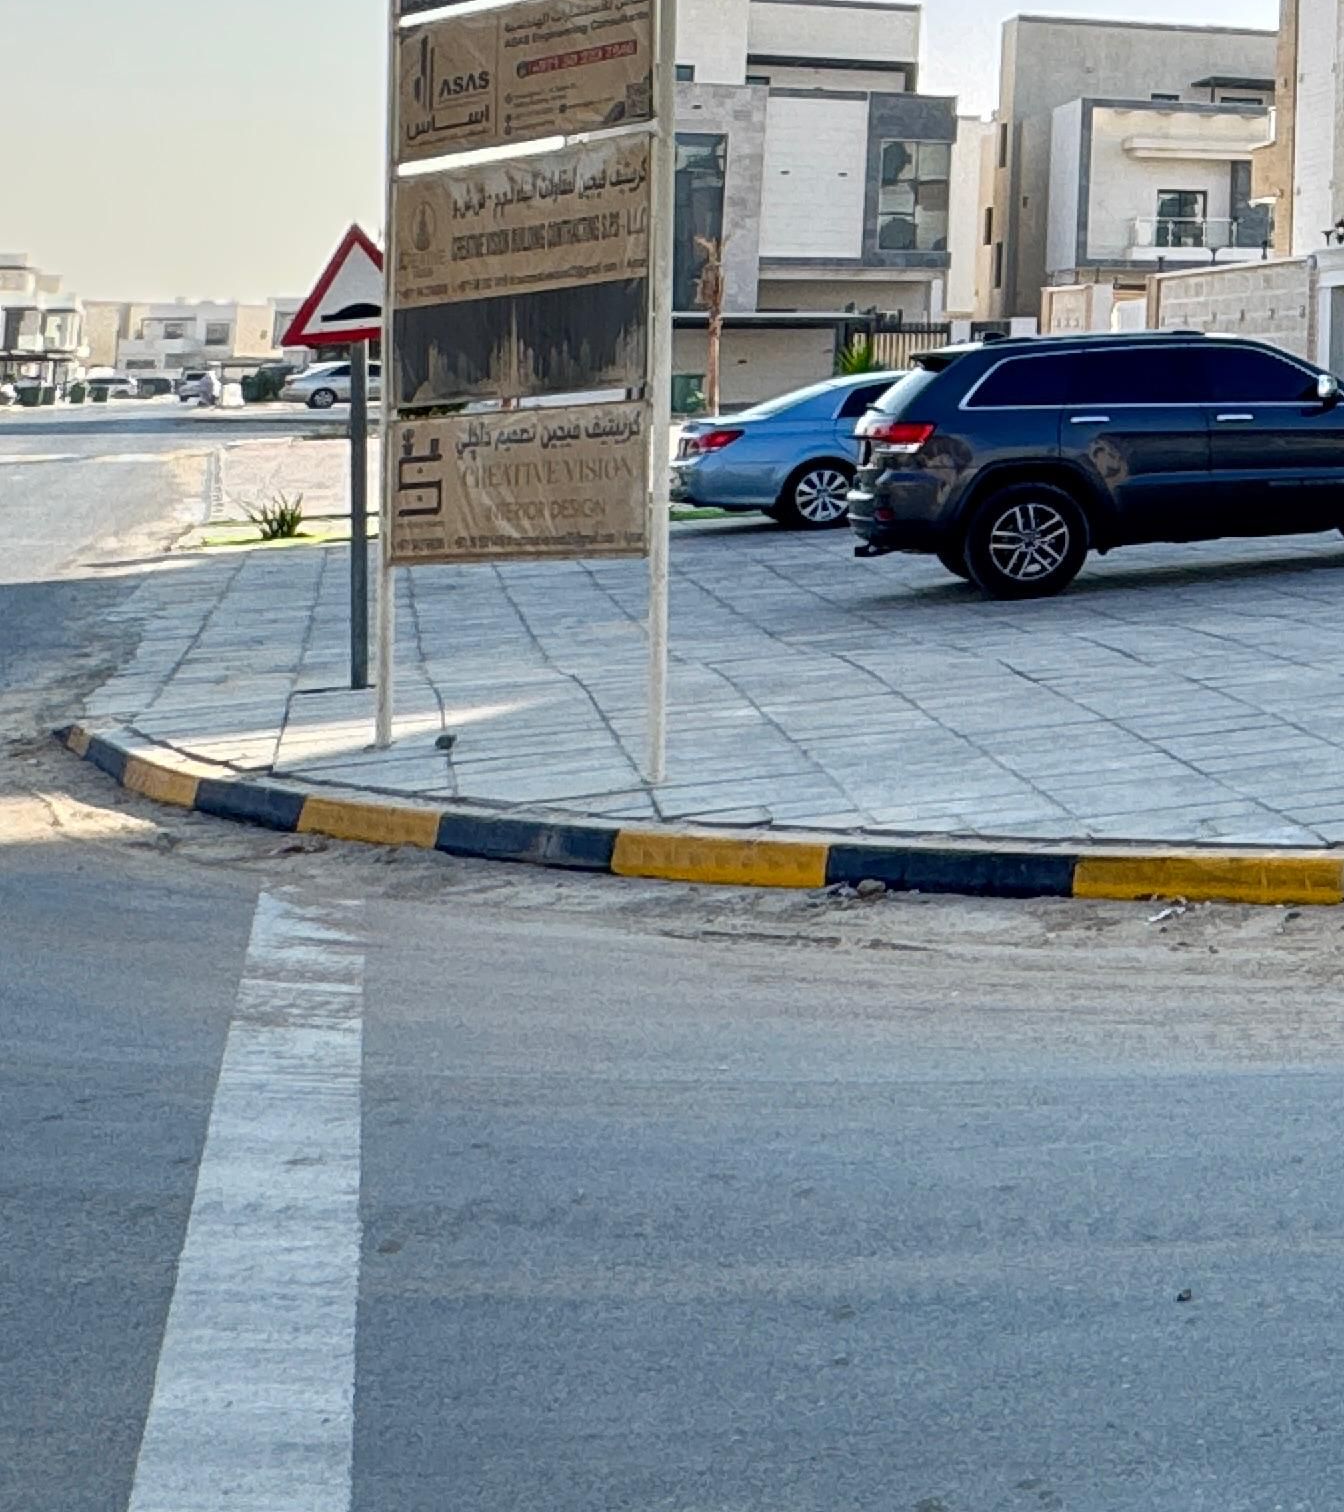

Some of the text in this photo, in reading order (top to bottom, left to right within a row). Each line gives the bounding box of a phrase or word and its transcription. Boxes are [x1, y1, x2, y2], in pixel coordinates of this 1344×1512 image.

[439, 70, 490, 97] ASAS
[562, 455, 636, 483] VISION
[551, 497, 606, 520] DESIGN
